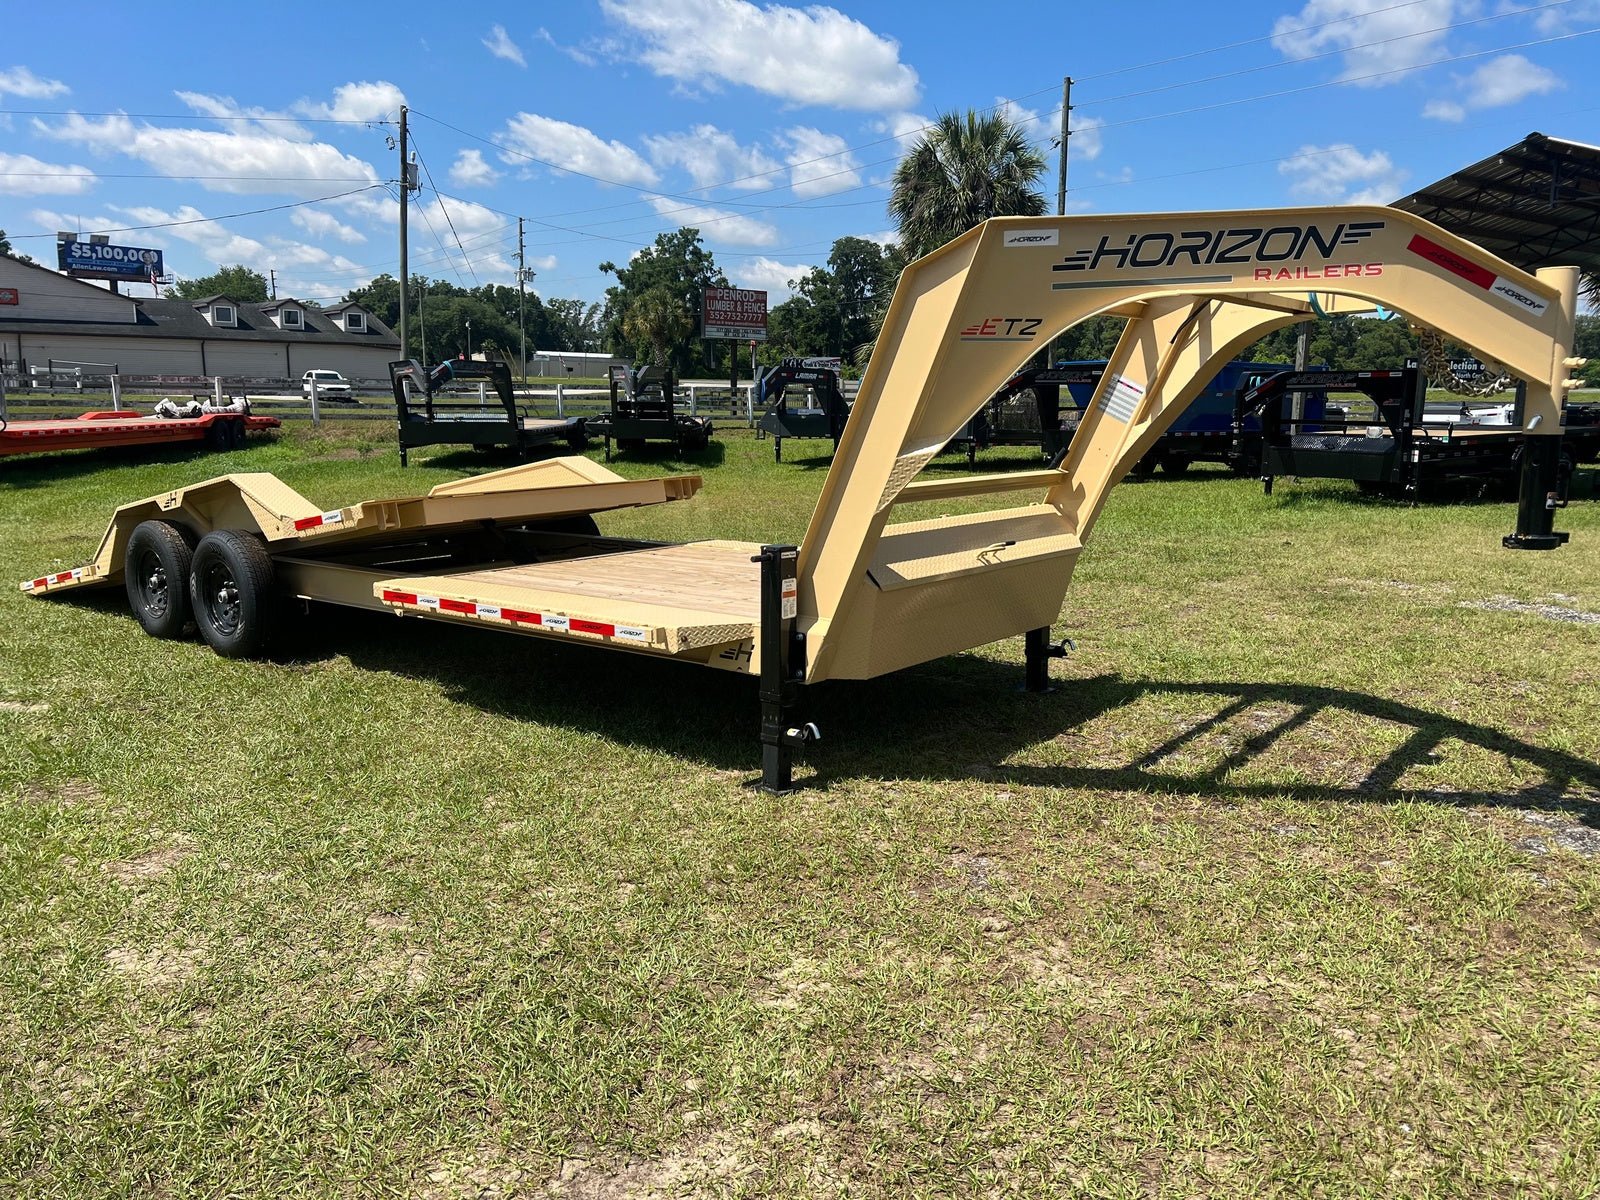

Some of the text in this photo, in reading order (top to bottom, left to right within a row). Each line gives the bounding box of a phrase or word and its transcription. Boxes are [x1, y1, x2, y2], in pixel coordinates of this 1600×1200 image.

[1087, 222, 1346, 271] HORIZON
[72, 263, 118, 272] AllenLaw.com
[1254, 262, 1384, 281] RAILERS
[717, 288, 755, 302] PENROD
[1499, 286, 1538, 309] HORIZON
[706, 299, 766, 313] LUMBER & FENCE
[709, 311, 763, 322] 352-732-7777
[1450, 360, 1478, 371] lection
[794, 372, 818, 380] LAMAR
